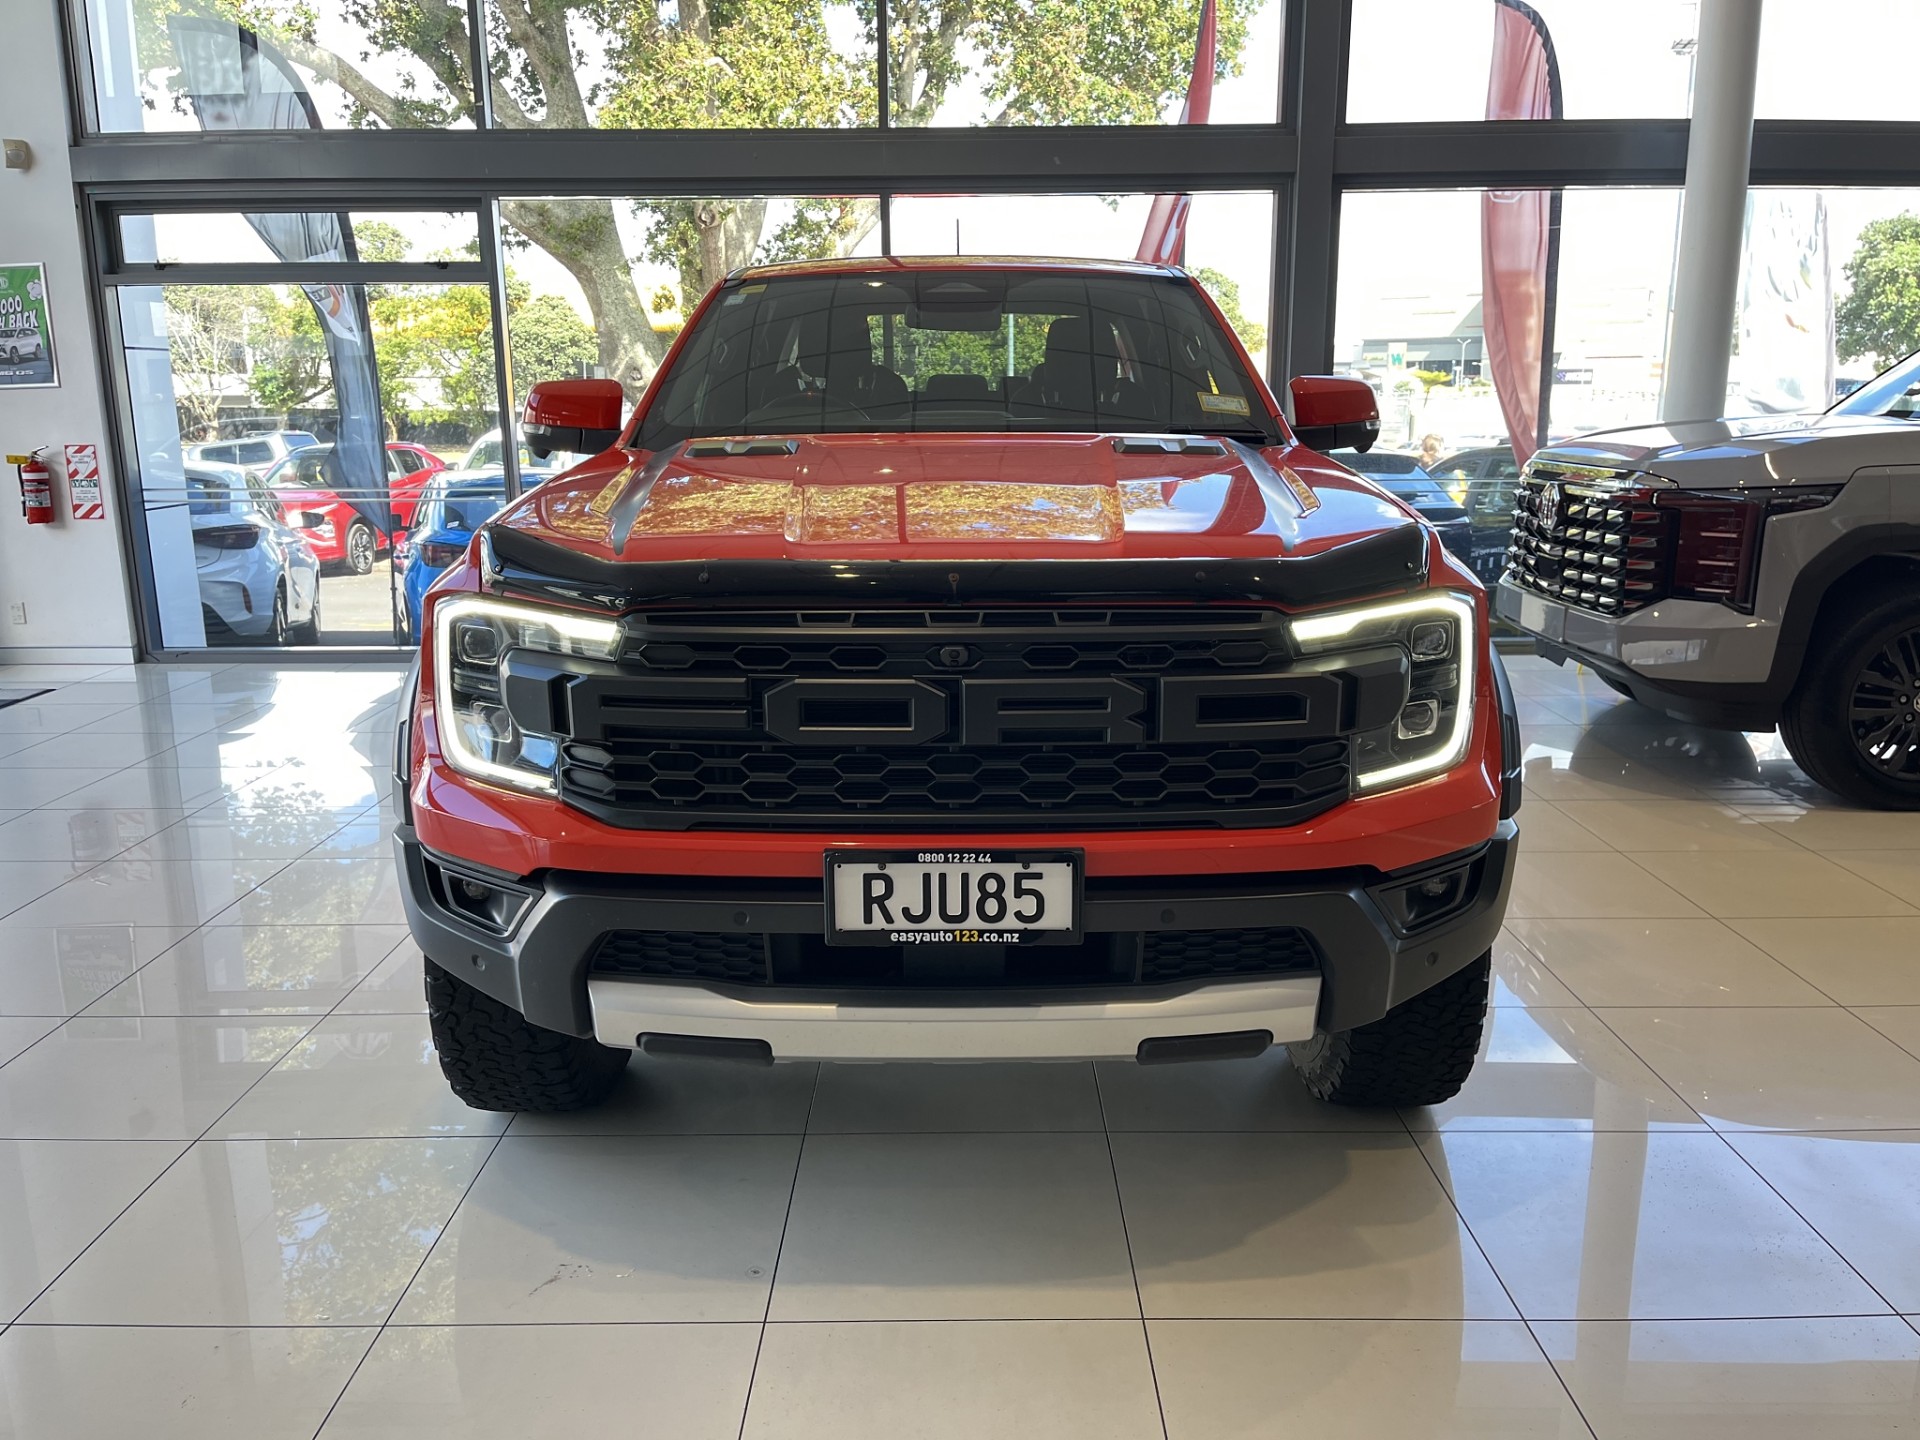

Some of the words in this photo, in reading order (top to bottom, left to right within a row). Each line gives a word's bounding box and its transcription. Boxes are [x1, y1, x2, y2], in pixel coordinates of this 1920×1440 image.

[9, 309, 39, 328] BACK
[566, 673, 1343, 746] FORD
[918, 853, 945, 863] 0800
[947, 853, 960, 863] 12
[962, 853, 976, 863] 22
[977, 853, 992, 863] 44
[863, 872, 1045, 924] RJU85
[890, 930, 1020, 945] easyauto123.co.nz
